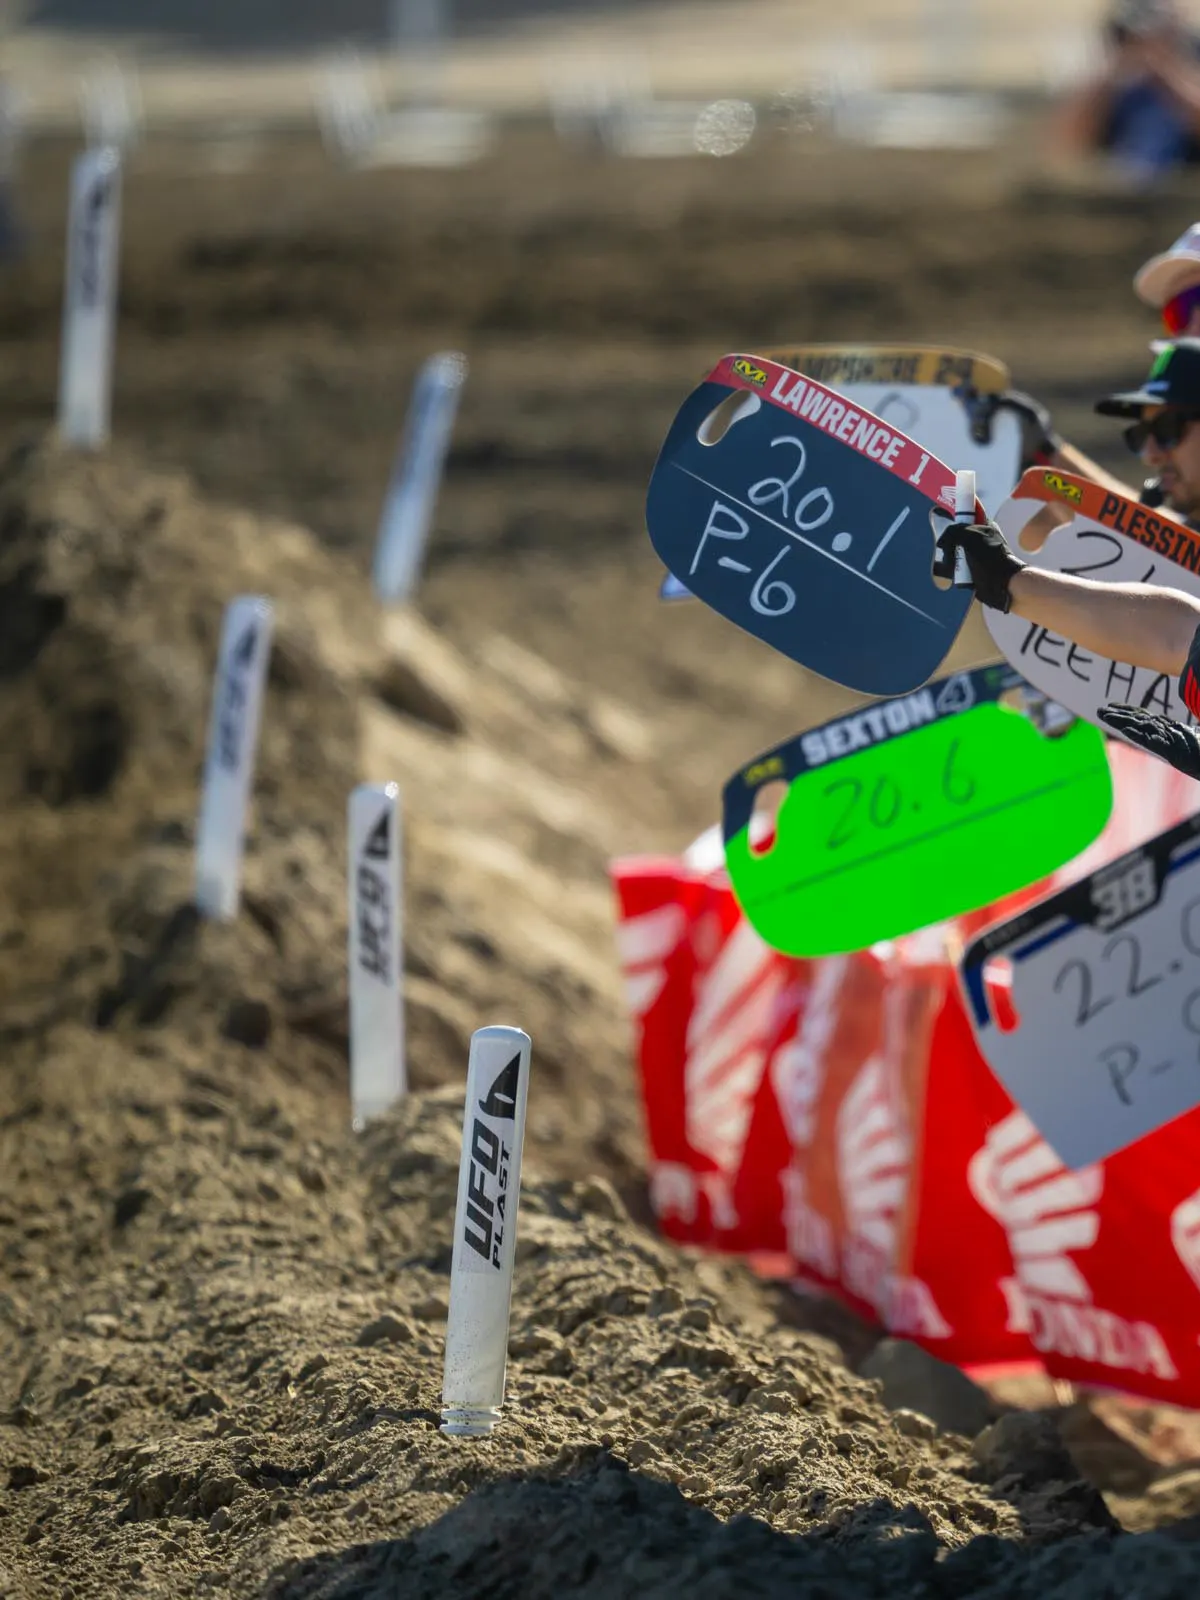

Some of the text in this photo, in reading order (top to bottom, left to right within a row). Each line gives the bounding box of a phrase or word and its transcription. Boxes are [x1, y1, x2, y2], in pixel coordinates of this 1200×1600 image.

[770, 371, 905, 468] LAWRENCE
[908, 454, 931, 486] 1
[688, 500, 797, 616] P-6
[747, 435, 911, 572] 20.1
[801, 688, 937, 768] SEXTON
[823, 737, 977, 850] 20.6
[1091, 857, 1157, 928] 38
[464, 1118, 499, 1261] UFO
[491, 1141, 513, 1271] PLAST
